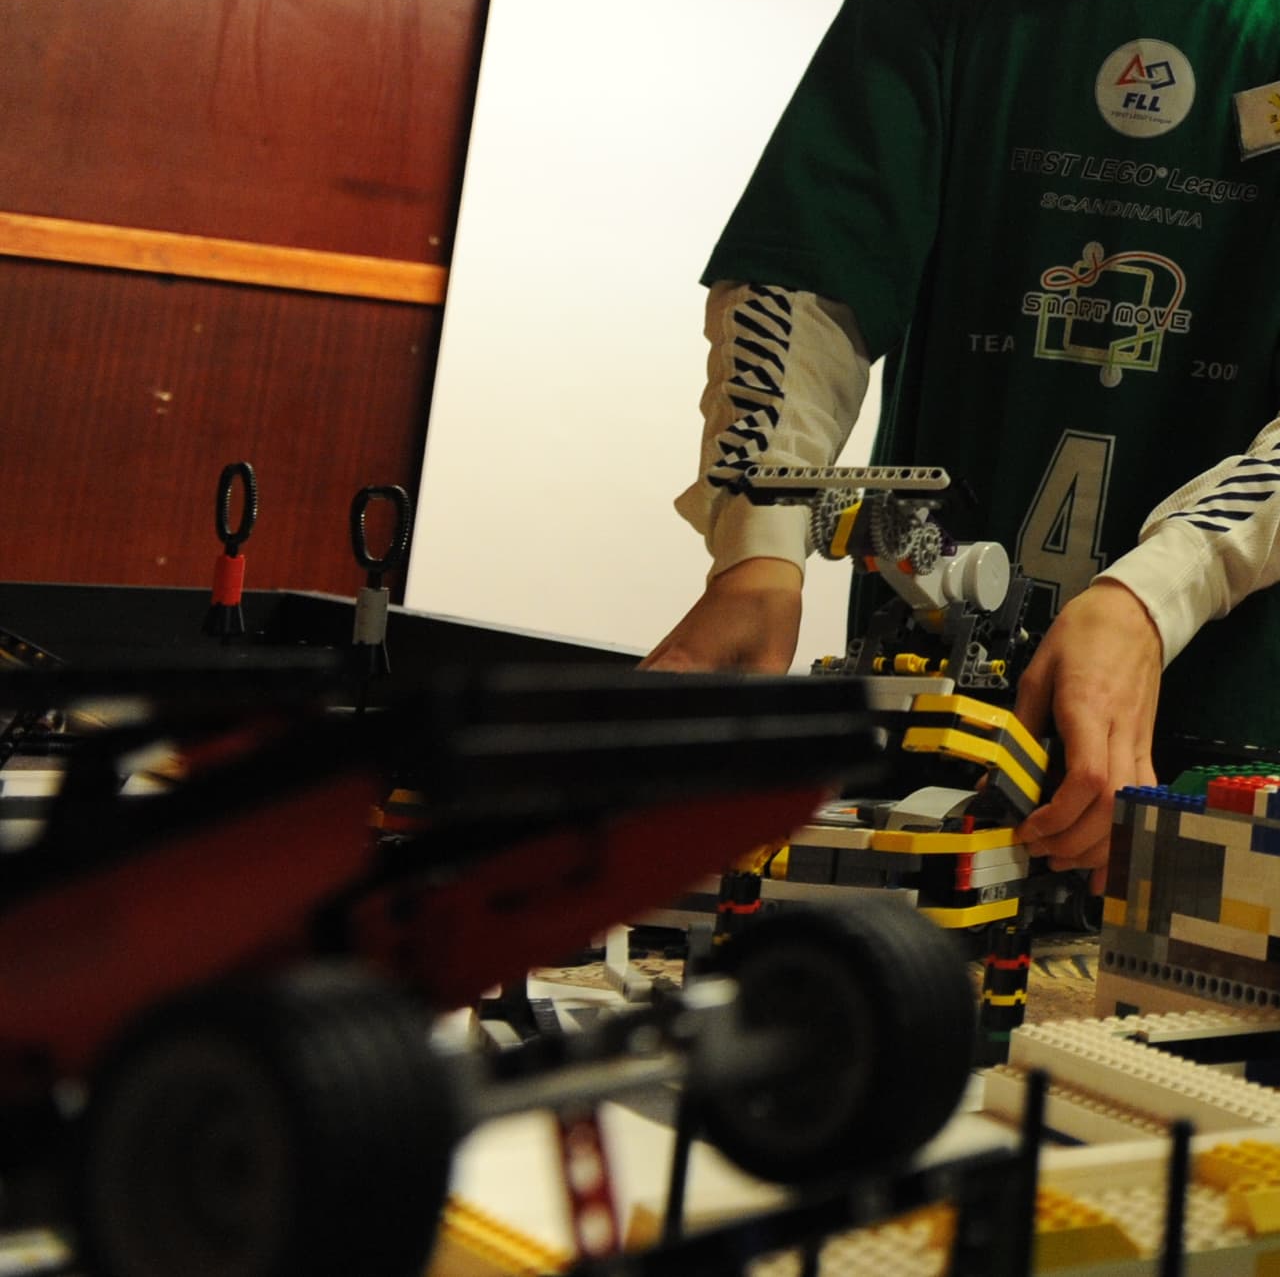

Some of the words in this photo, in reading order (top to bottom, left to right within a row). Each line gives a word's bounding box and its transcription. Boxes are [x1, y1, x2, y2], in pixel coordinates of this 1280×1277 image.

[1122, 92, 1161, 113] FLL
[1009, 146, 1081, 177] FIRST
[1165, 167, 1260, 204] League
[1039, 191, 1204, 230] SCANDINAVIA
[1021, 292, 1112, 322] SMART
[1112, 303, 1192, 334] MOVE
[968, 333, 1016, 354] TEA
[1189, 359, 1240, 381] 200
[1015, 428, 1117, 618] 4
